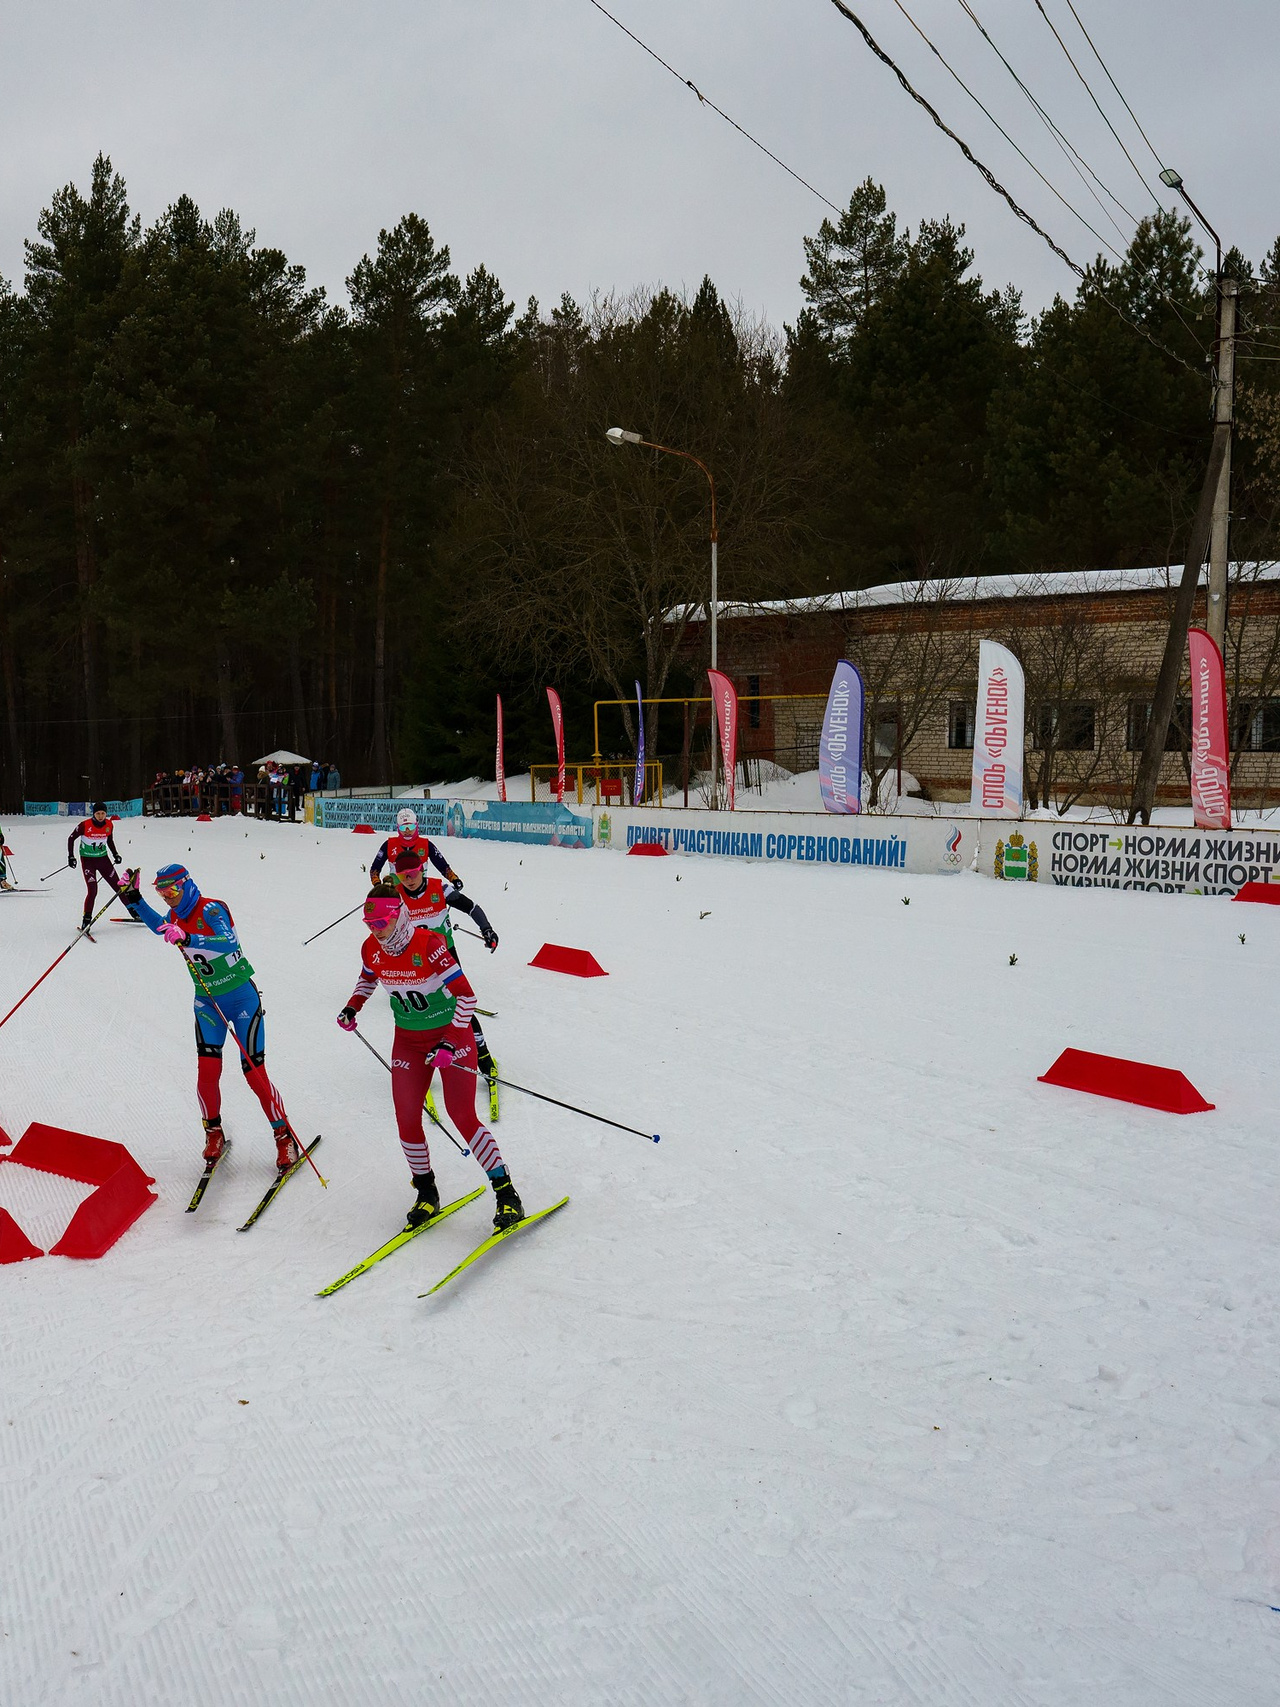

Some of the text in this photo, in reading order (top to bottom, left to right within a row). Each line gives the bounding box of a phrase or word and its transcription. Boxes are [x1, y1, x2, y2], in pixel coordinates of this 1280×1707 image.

[627, 825, 907, 868] ПРИВЕТ УЧАСТНИКАМ СОРЕВНОВАНИЙ!
[1052, 832, 1109, 853] СПОРТ
[1124, 835, 1201, 859] НОРМА
[1051, 853, 1273, 885] НОРМА ЖИЗНИ СПОРТ
[232, 950, 242, 962] 13
[381, 970, 417, 978] ФЕДЕРАЦИЯ
[391, 990, 430, 1013] 10
[333, 1264, 365, 1289] FISCHER
